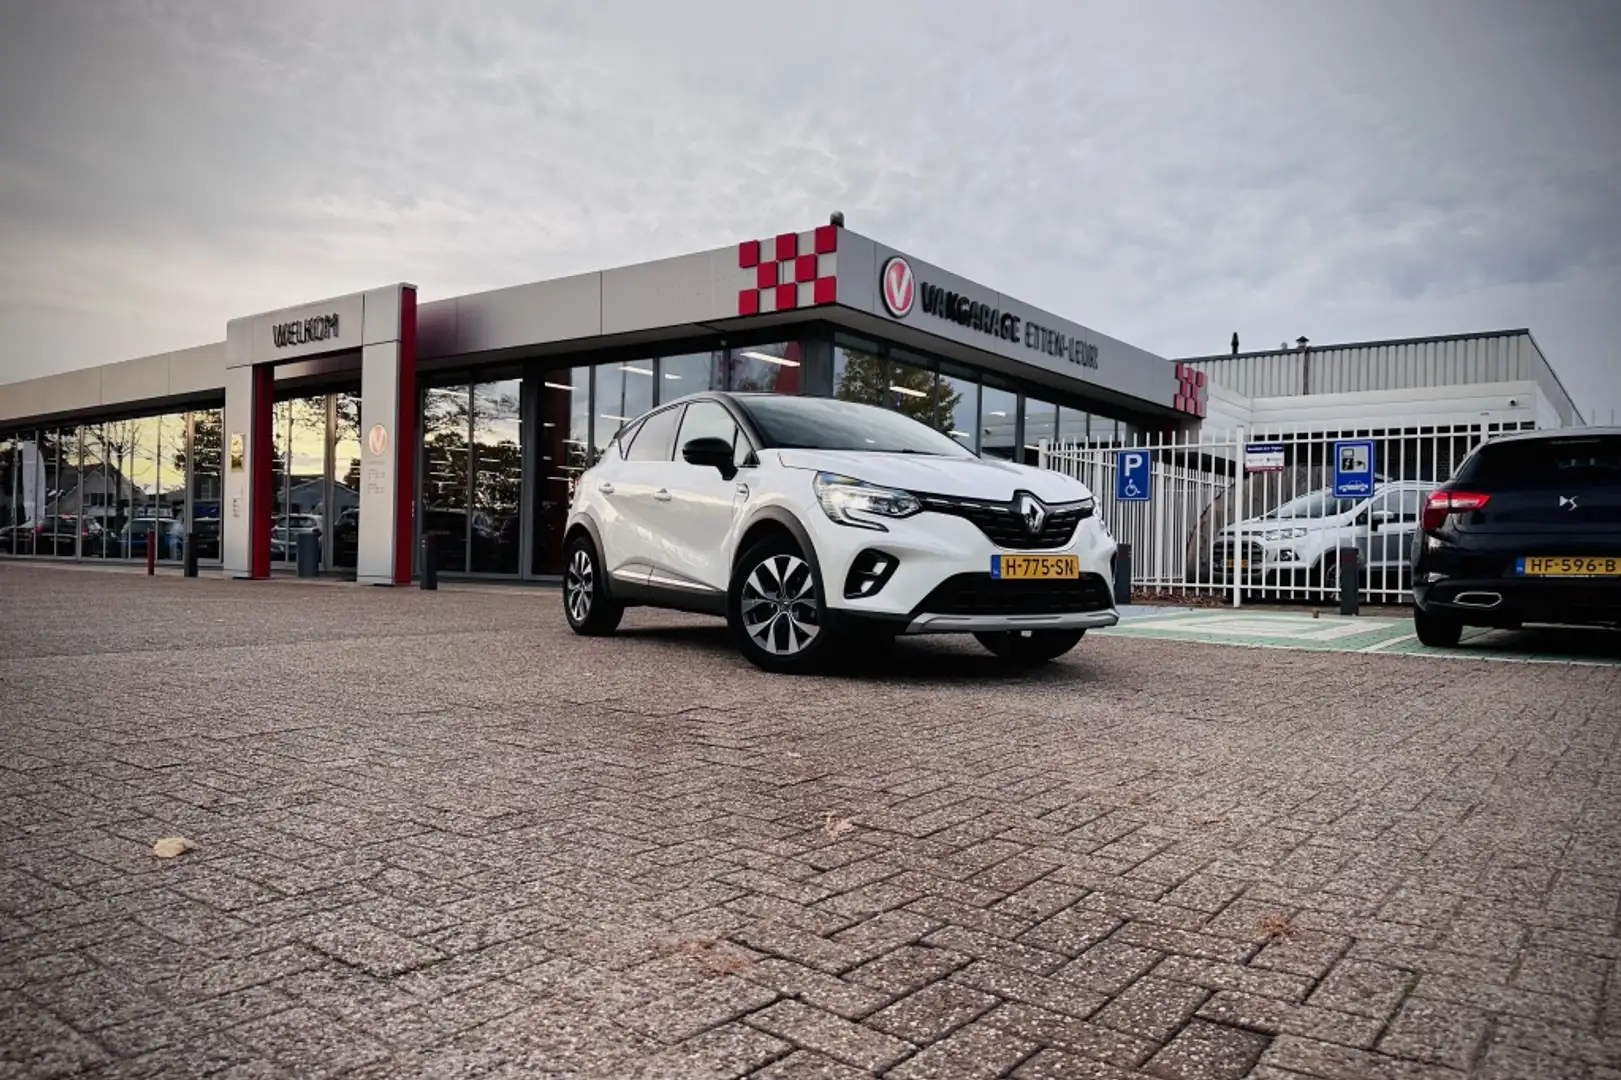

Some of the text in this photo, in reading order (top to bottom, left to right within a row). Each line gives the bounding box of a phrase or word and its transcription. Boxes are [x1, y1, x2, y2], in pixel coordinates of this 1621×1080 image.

[920, 281, 1021, 343] VAKGARAGE
[272, 312, 340, 348] WELKOM
[1124, 454, 1143, 477] P
[1006, 558, 1074, 576] H-775-SN
